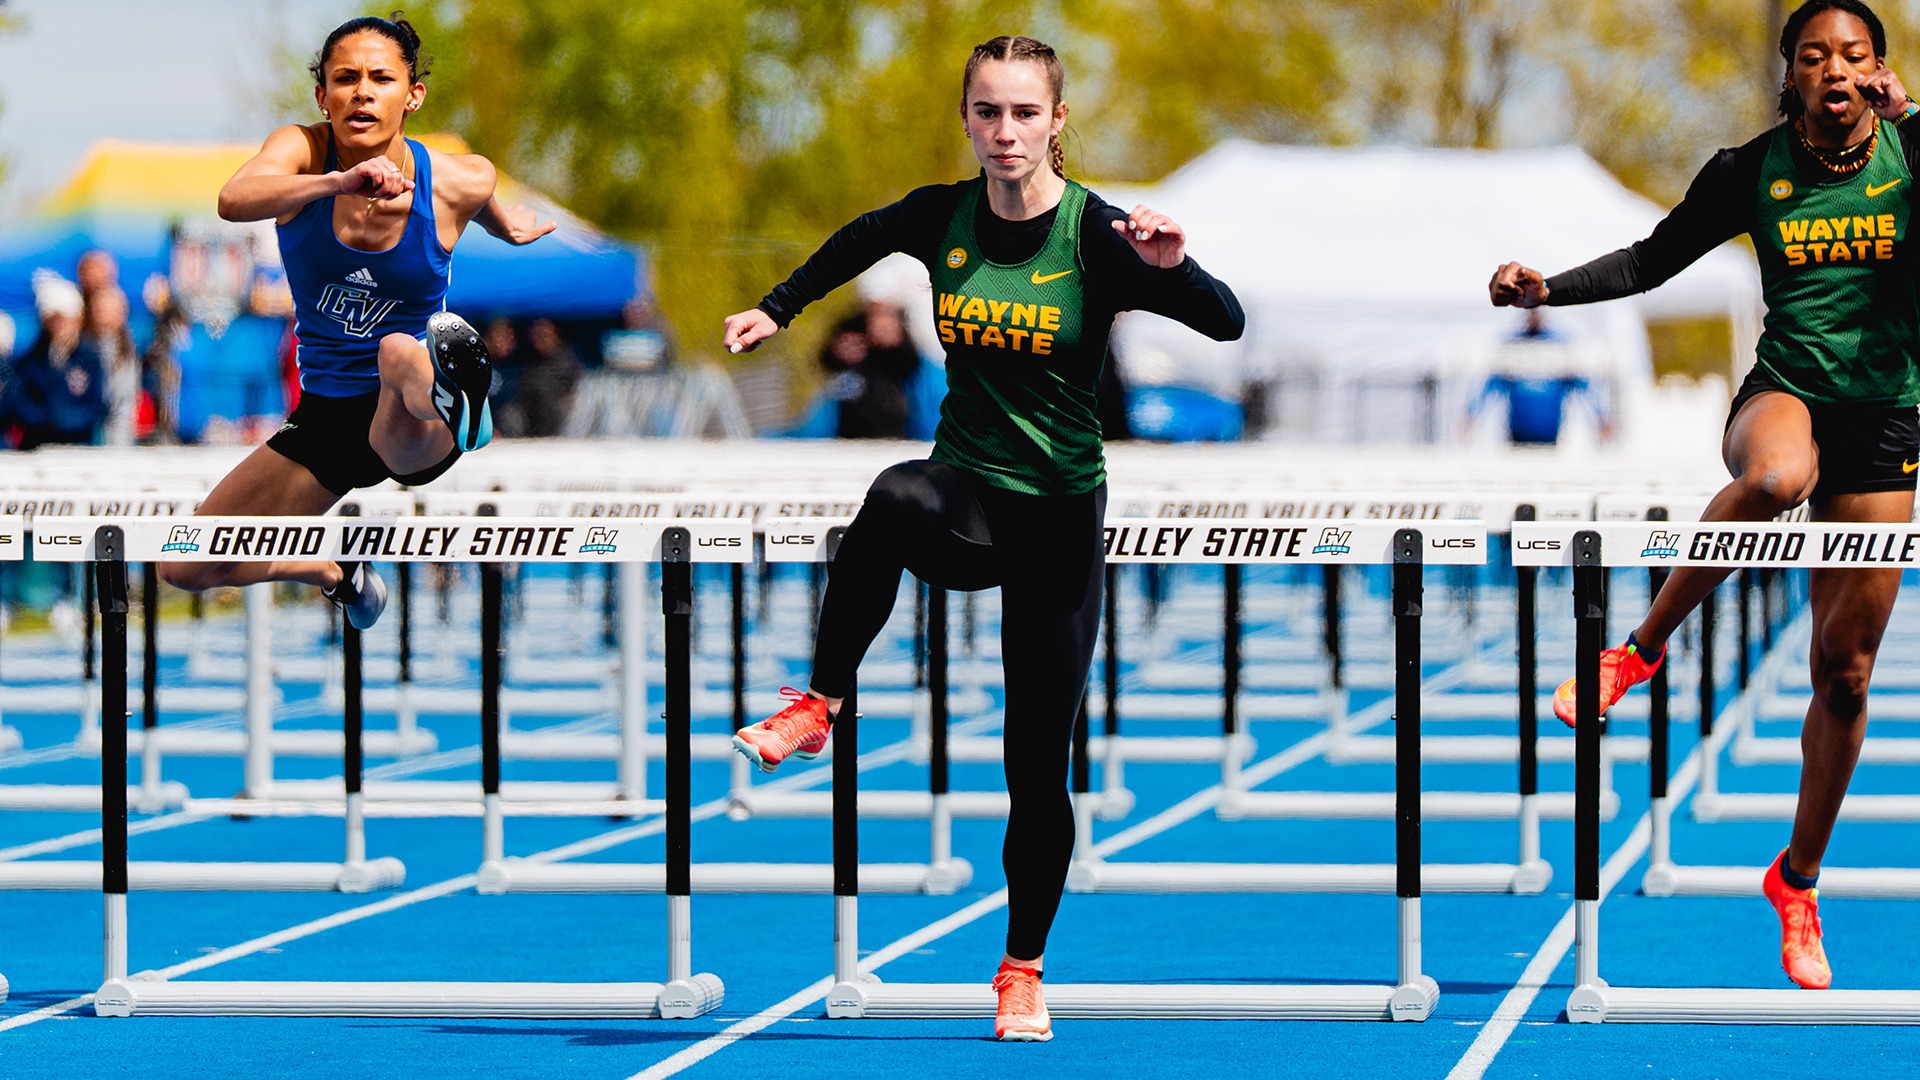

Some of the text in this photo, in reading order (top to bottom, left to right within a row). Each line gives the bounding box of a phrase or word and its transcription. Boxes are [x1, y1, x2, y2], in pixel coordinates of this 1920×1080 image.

[1778, 213, 1897, 243] WAYNE
[1784, 239, 1894, 266] STATE
[345, 276, 378, 288] adidas
[317, 284, 403, 338] GV
[938, 293, 1062, 331] WAYNE
[938, 320, 1055, 356] STATE
[0, 501, 73, 520] RAND
[38, 535, 83, 545] UCS
[208, 526, 575, 556] GRAND VALLEY STATE
[698, 537, 742, 547] UCS
[771, 535, 815, 545] UCS
[1104, 527, 1308, 557] ALLEY STATE
[1432, 538, 1476, 548] UCS
[1517, 540, 1561, 550] UCS
[1687, 531, 1920, 562] GRAND VALLE
